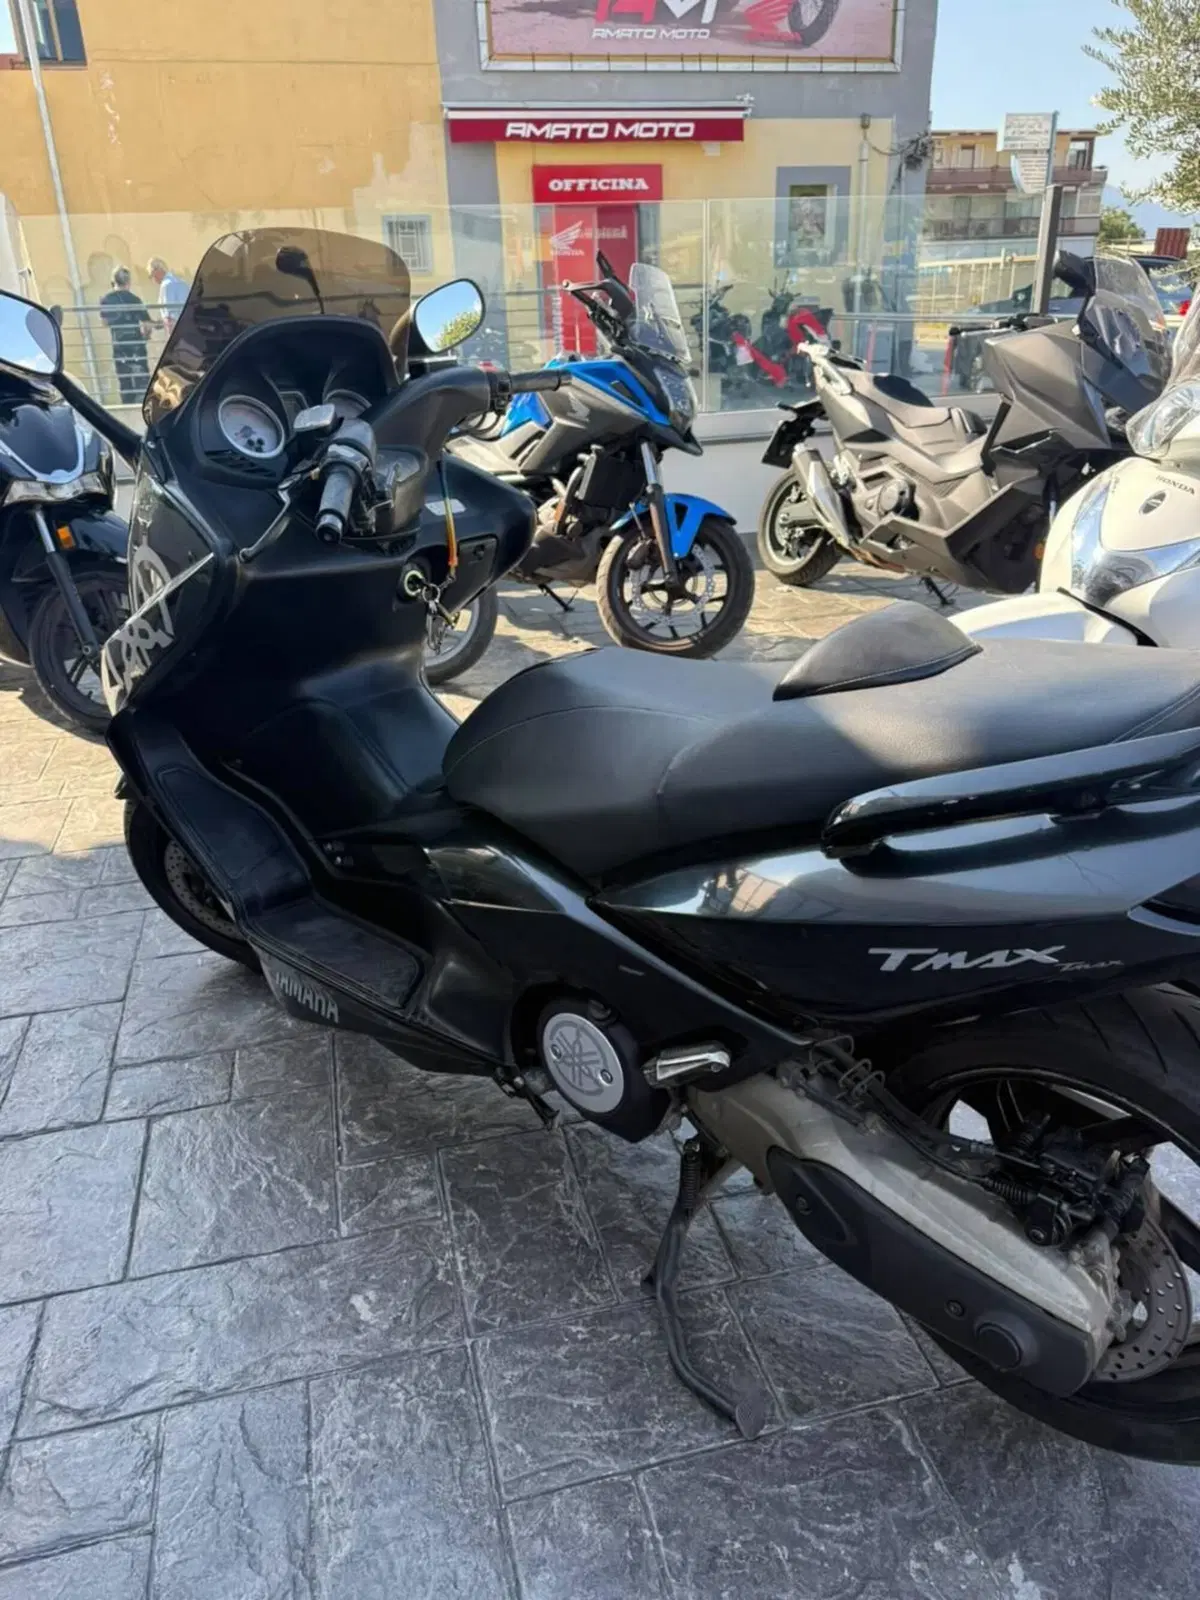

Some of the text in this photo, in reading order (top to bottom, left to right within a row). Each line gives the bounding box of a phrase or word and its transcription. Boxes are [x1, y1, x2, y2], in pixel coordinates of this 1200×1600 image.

[592, 28, 710, 39] AMATO MOTO
[505, 122, 695, 139] AMATO MOTO
[548, 178, 649, 192] OFFICINA
[1156, 475, 1195, 495] HONDA
